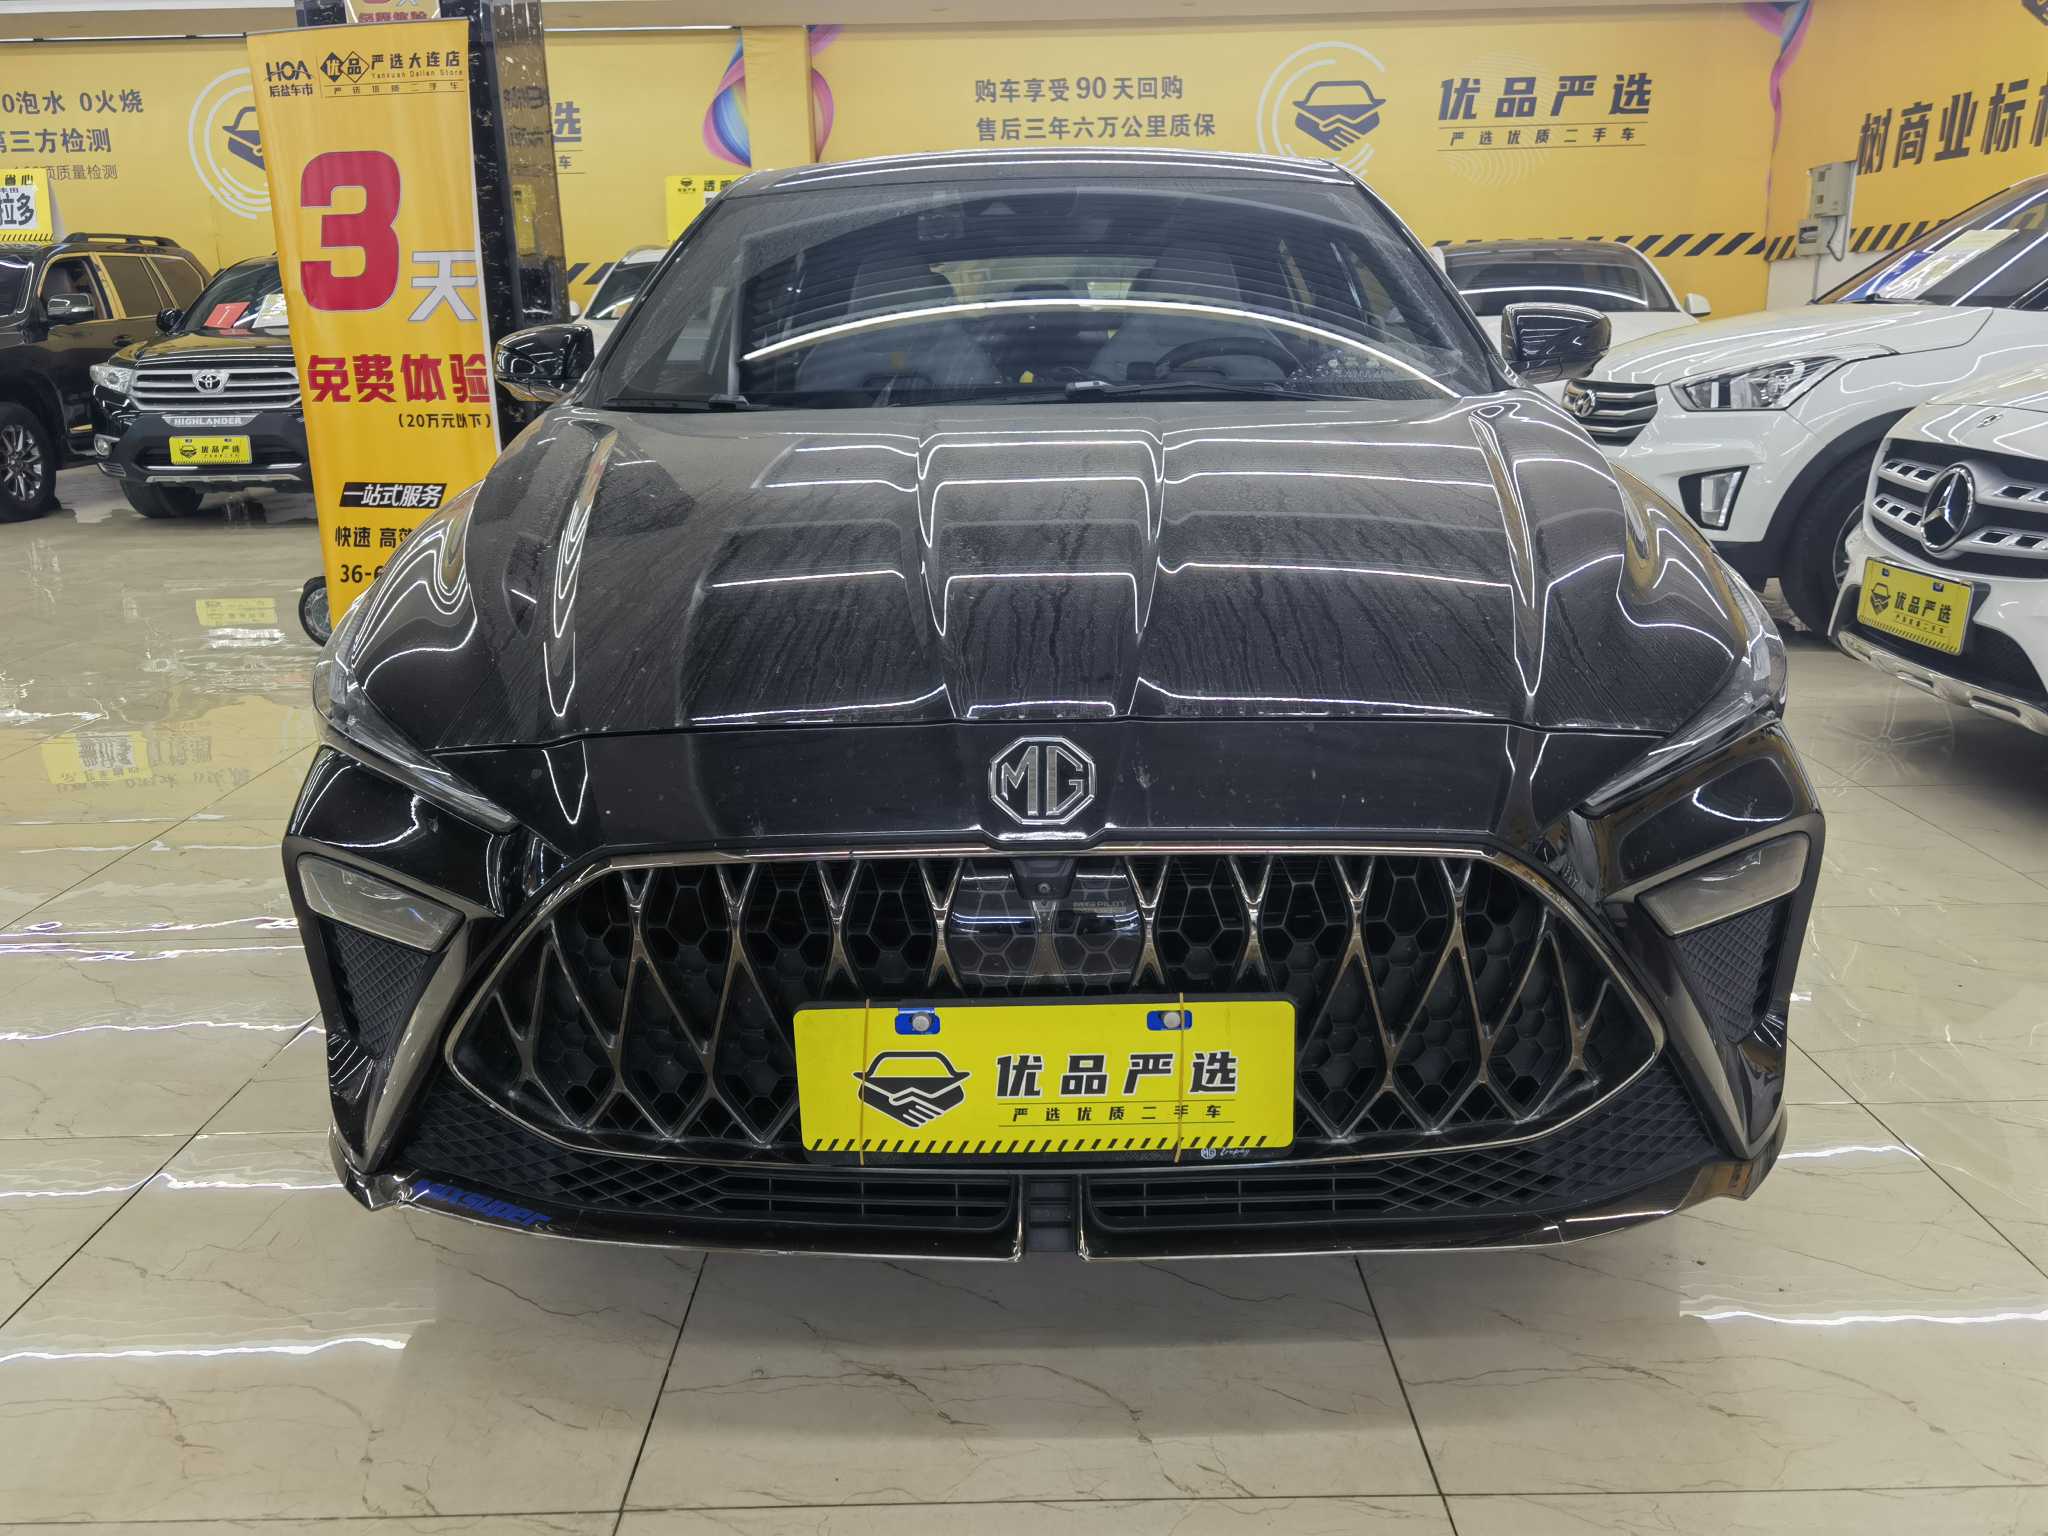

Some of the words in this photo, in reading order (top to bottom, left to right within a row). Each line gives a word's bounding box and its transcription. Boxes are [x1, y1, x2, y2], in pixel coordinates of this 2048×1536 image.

[266, 60, 312, 82] HOA
[269, 83, 313, 97] 后盐车市
[1438, 72, 1652, 121] 优品严选
[976, 112, 1217, 142] 售后三年六万公里质保
[1449, 127, 1636, 147] 严选优质二手车
[307, 353, 491, 404] 免费体验
[174, 416, 243, 426] HIGHLANDER
[343, 485, 442, 508] 一站式服务
[335, 526, 371, 548] 快速
[1001, 745, 1084, 817] MG
[995, 1050, 1239, 1098] 优品严选
[1012, 1104, 1222, 1122] 严选优质二手车
